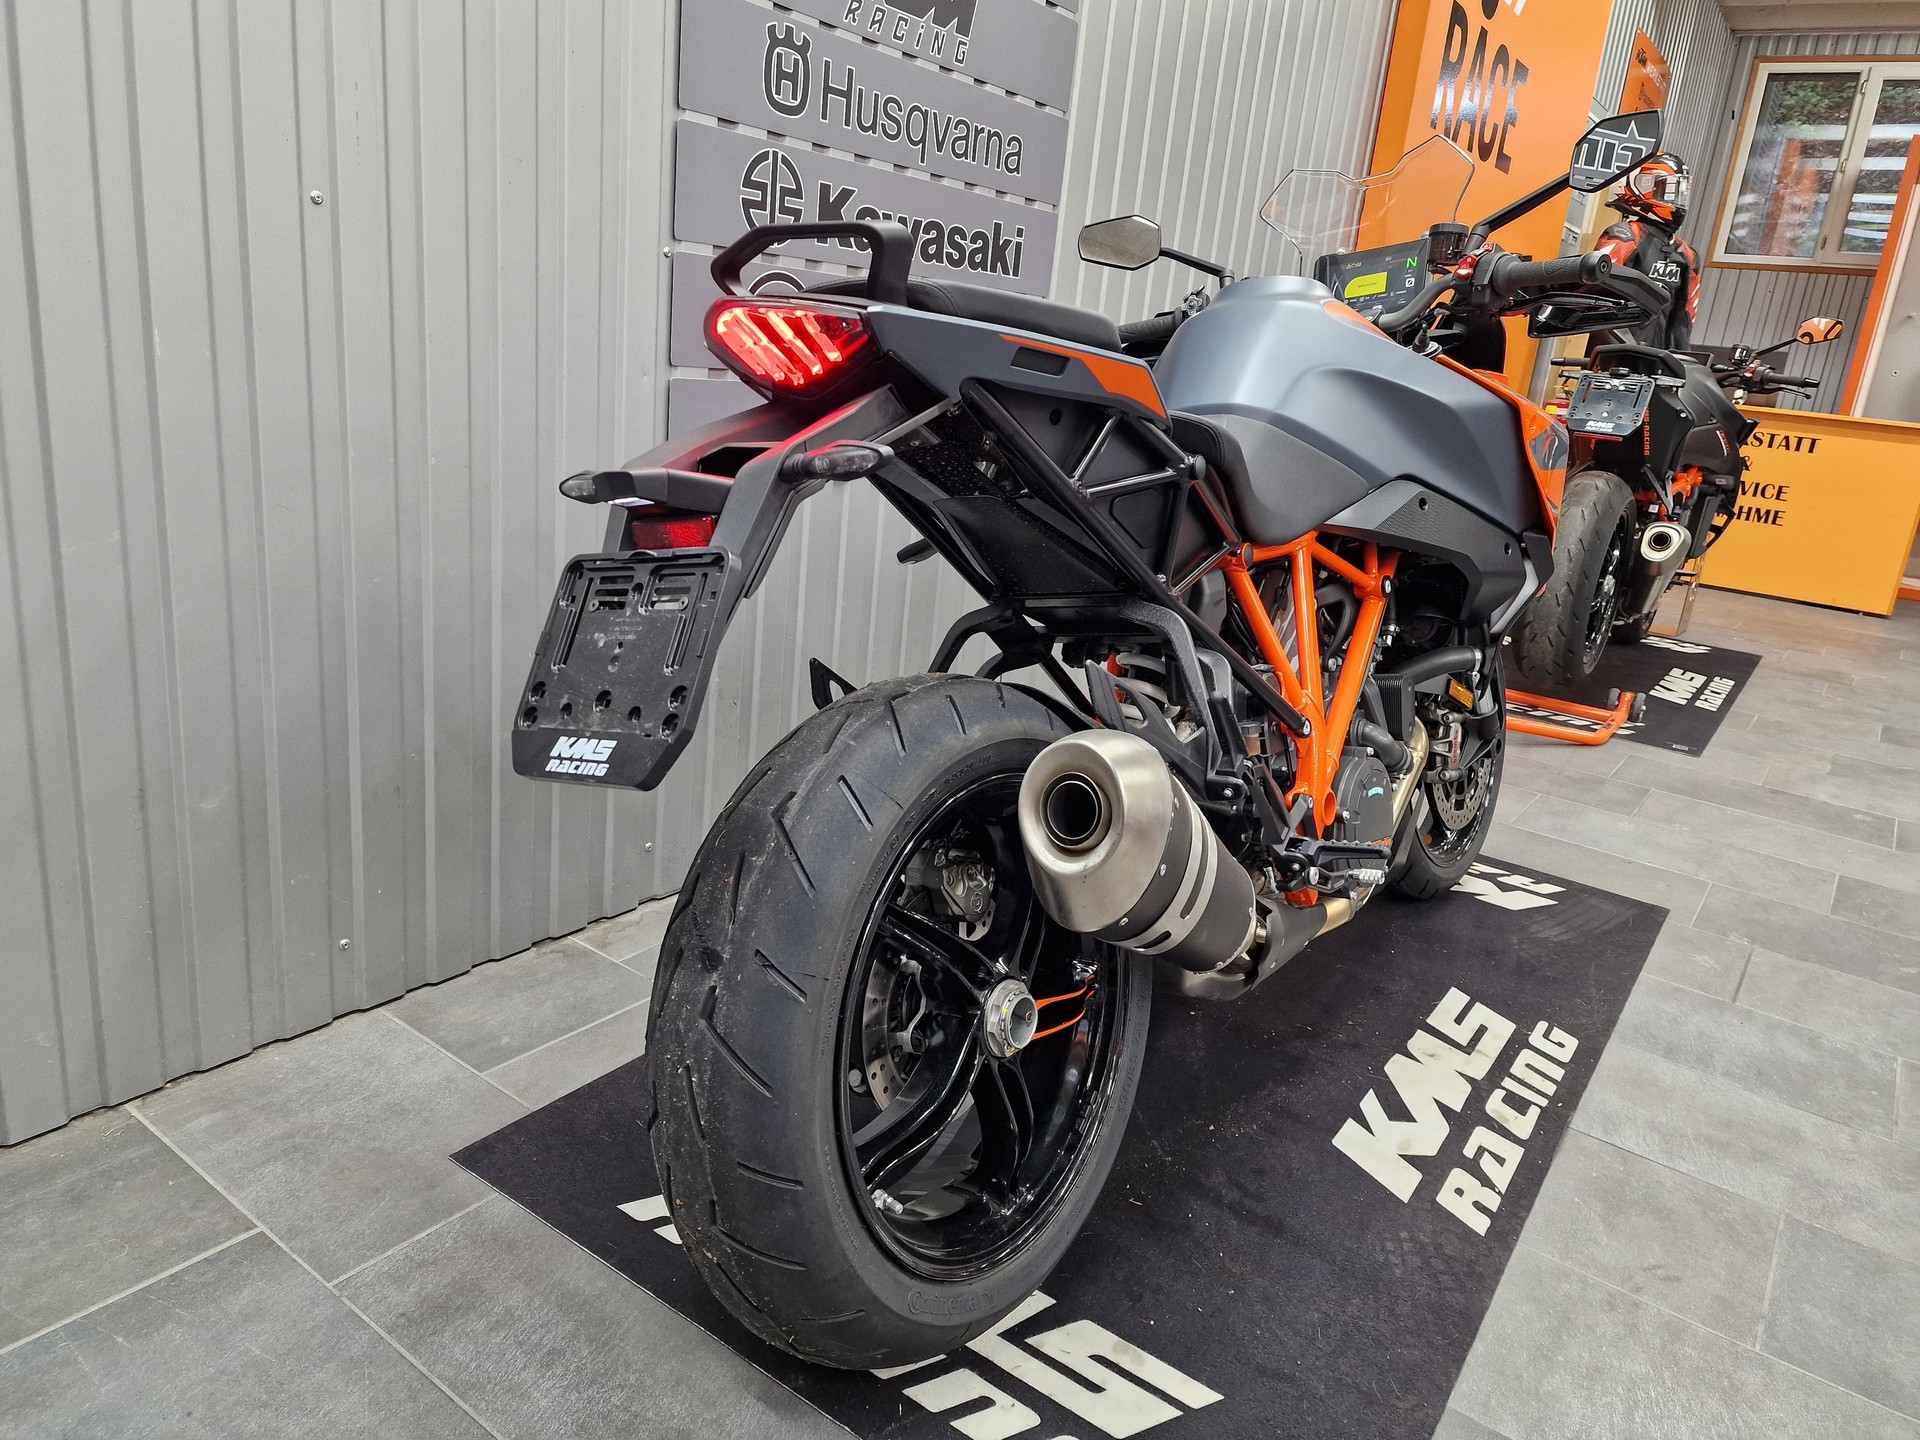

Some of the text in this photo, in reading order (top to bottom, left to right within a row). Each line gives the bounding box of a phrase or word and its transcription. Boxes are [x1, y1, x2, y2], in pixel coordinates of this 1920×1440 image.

[1430, 1, 1529, 175] RACE
[820, 58, 1024, 177] Husqvarna
[1406, 256, 1418, 269] N
[1648, 260, 1681, 282] KTM
[1648, 667, 1708, 706] KMS
[1694, 676, 1736, 712] RACING
[550, 736, 618, 762] KMS
[545, 759, 610, 777] RACING
[1331, 986, 1517, 1204] KMS
[1436, 1020, 1580, 1237] RACING
